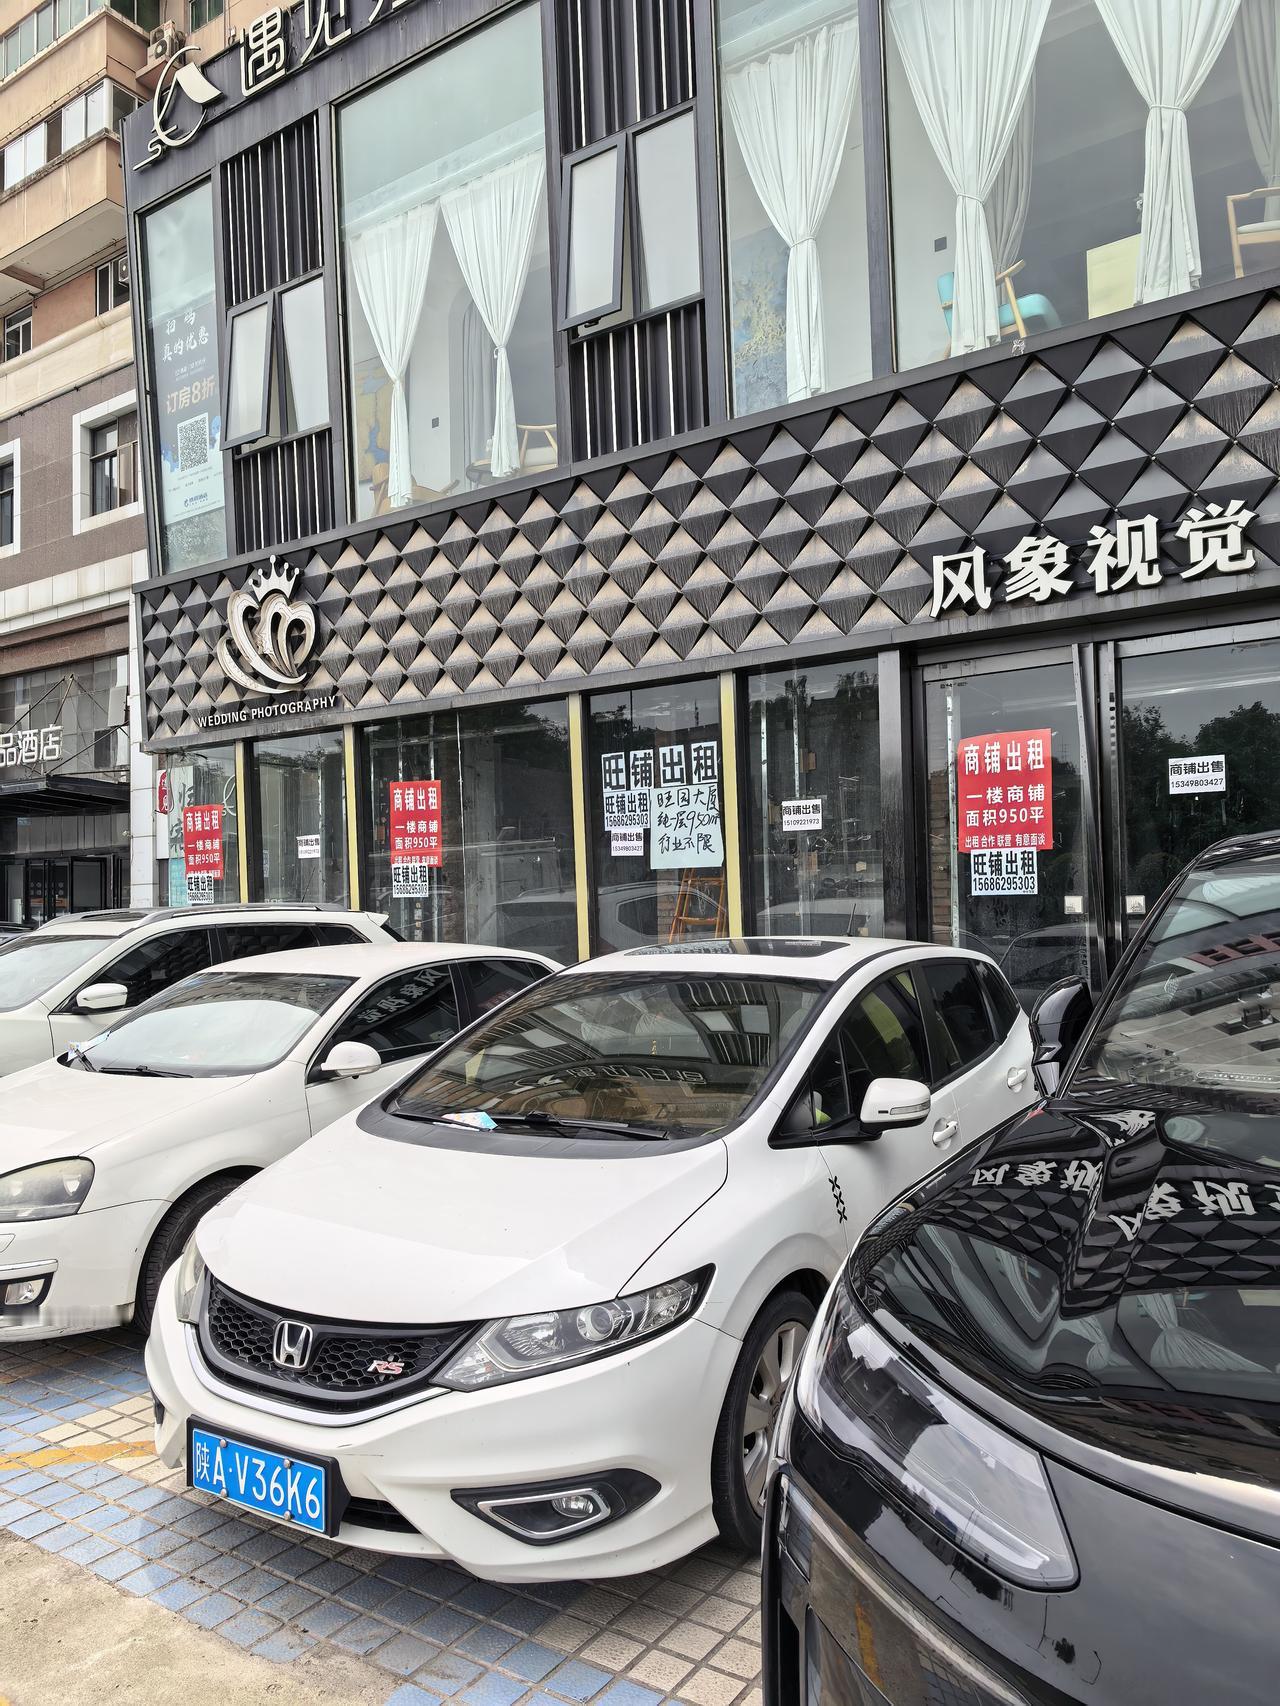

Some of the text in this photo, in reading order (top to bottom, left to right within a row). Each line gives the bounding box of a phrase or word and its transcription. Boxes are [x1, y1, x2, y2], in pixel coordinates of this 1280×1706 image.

[166, 375, 216, 414] 订房8折
[929, 499, 1257, 619] 风象视觉
[198, 696, 336, 728] WEDDING PHOTOGRAPHY
[964, 739, 1045, 775] 商铺出租
[602, 745, 717, 790] 旺铺出租
[1170, 761, 1224, 776] 商铺出售
[1171, 778, 1224, 788] 15349803427
[393, 787, 438, 811] 商铺出租
[966, 784, 1045, 805] 一楼商铺
[605, 792, 649, 815] 旺铺出租
[783, 804, 820, 815] 商铺出售
[186, 810, 220, 832] 商铺出租
[605, 813, 649, 828] 15686295303
[784, 818, 820, 826] 15109221973
[966, 806, 1045, 827] 面积950平
[395, 820, 438, 834] 一楼商铺
[395, 837, 438, 849] 面积950平
[611, 832, 642, 843] 商铺出售
[658, 833, 716, 855] 行业不限
[965, 835, 979, 848] 出租
[981, 835, 995, 847] 合作
[1015, 833, 1045, 846] 有意面谈
[187, 839, 220, 853] 一楼商铺
[187, 854, 221, 866] 面积950平
[973, 850, 1036, 877] 旺铺出租
[393, 865, 428, 884] 旺铺出租
[187, 875, 213, 891] 旺铺出租
[973, 876, 1036, 892] 15686295303
[367, 1359, 405, 1375] RS
